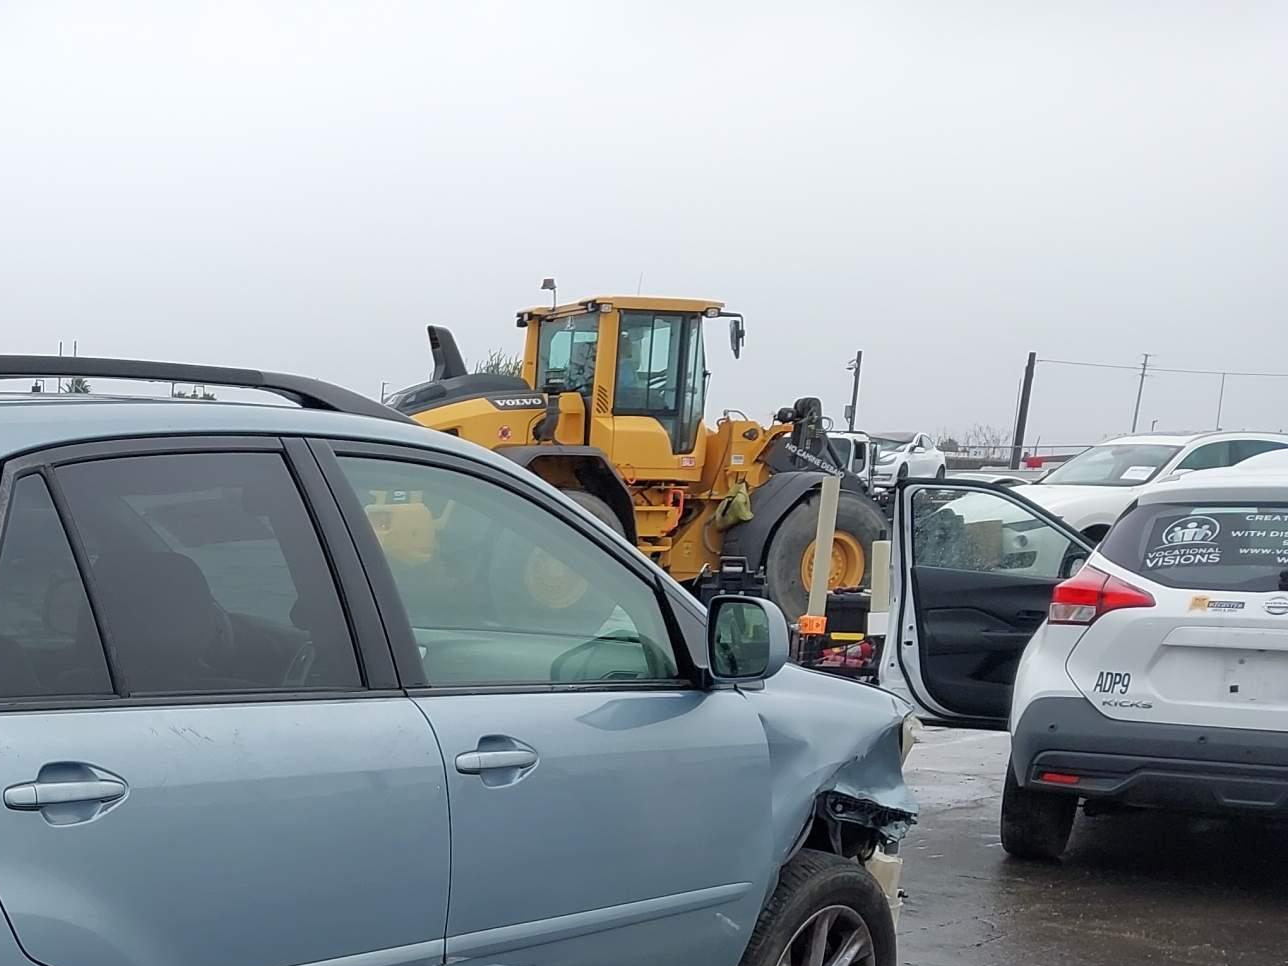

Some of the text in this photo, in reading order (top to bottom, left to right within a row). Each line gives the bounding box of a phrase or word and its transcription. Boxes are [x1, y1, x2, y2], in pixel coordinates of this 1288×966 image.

[494, 398, 542, 406] VOLVO
[785, 443, 797, 453] NO
[797, 449, 822, 466] CAMINE
[1148, 547, 1223, 558] VOCATIONAL
[1146, 553, 1220, 567] VISIONS
[1093, 671, 1131, 695] ADP9
[1102, 700, 1153, 709] KICKS
